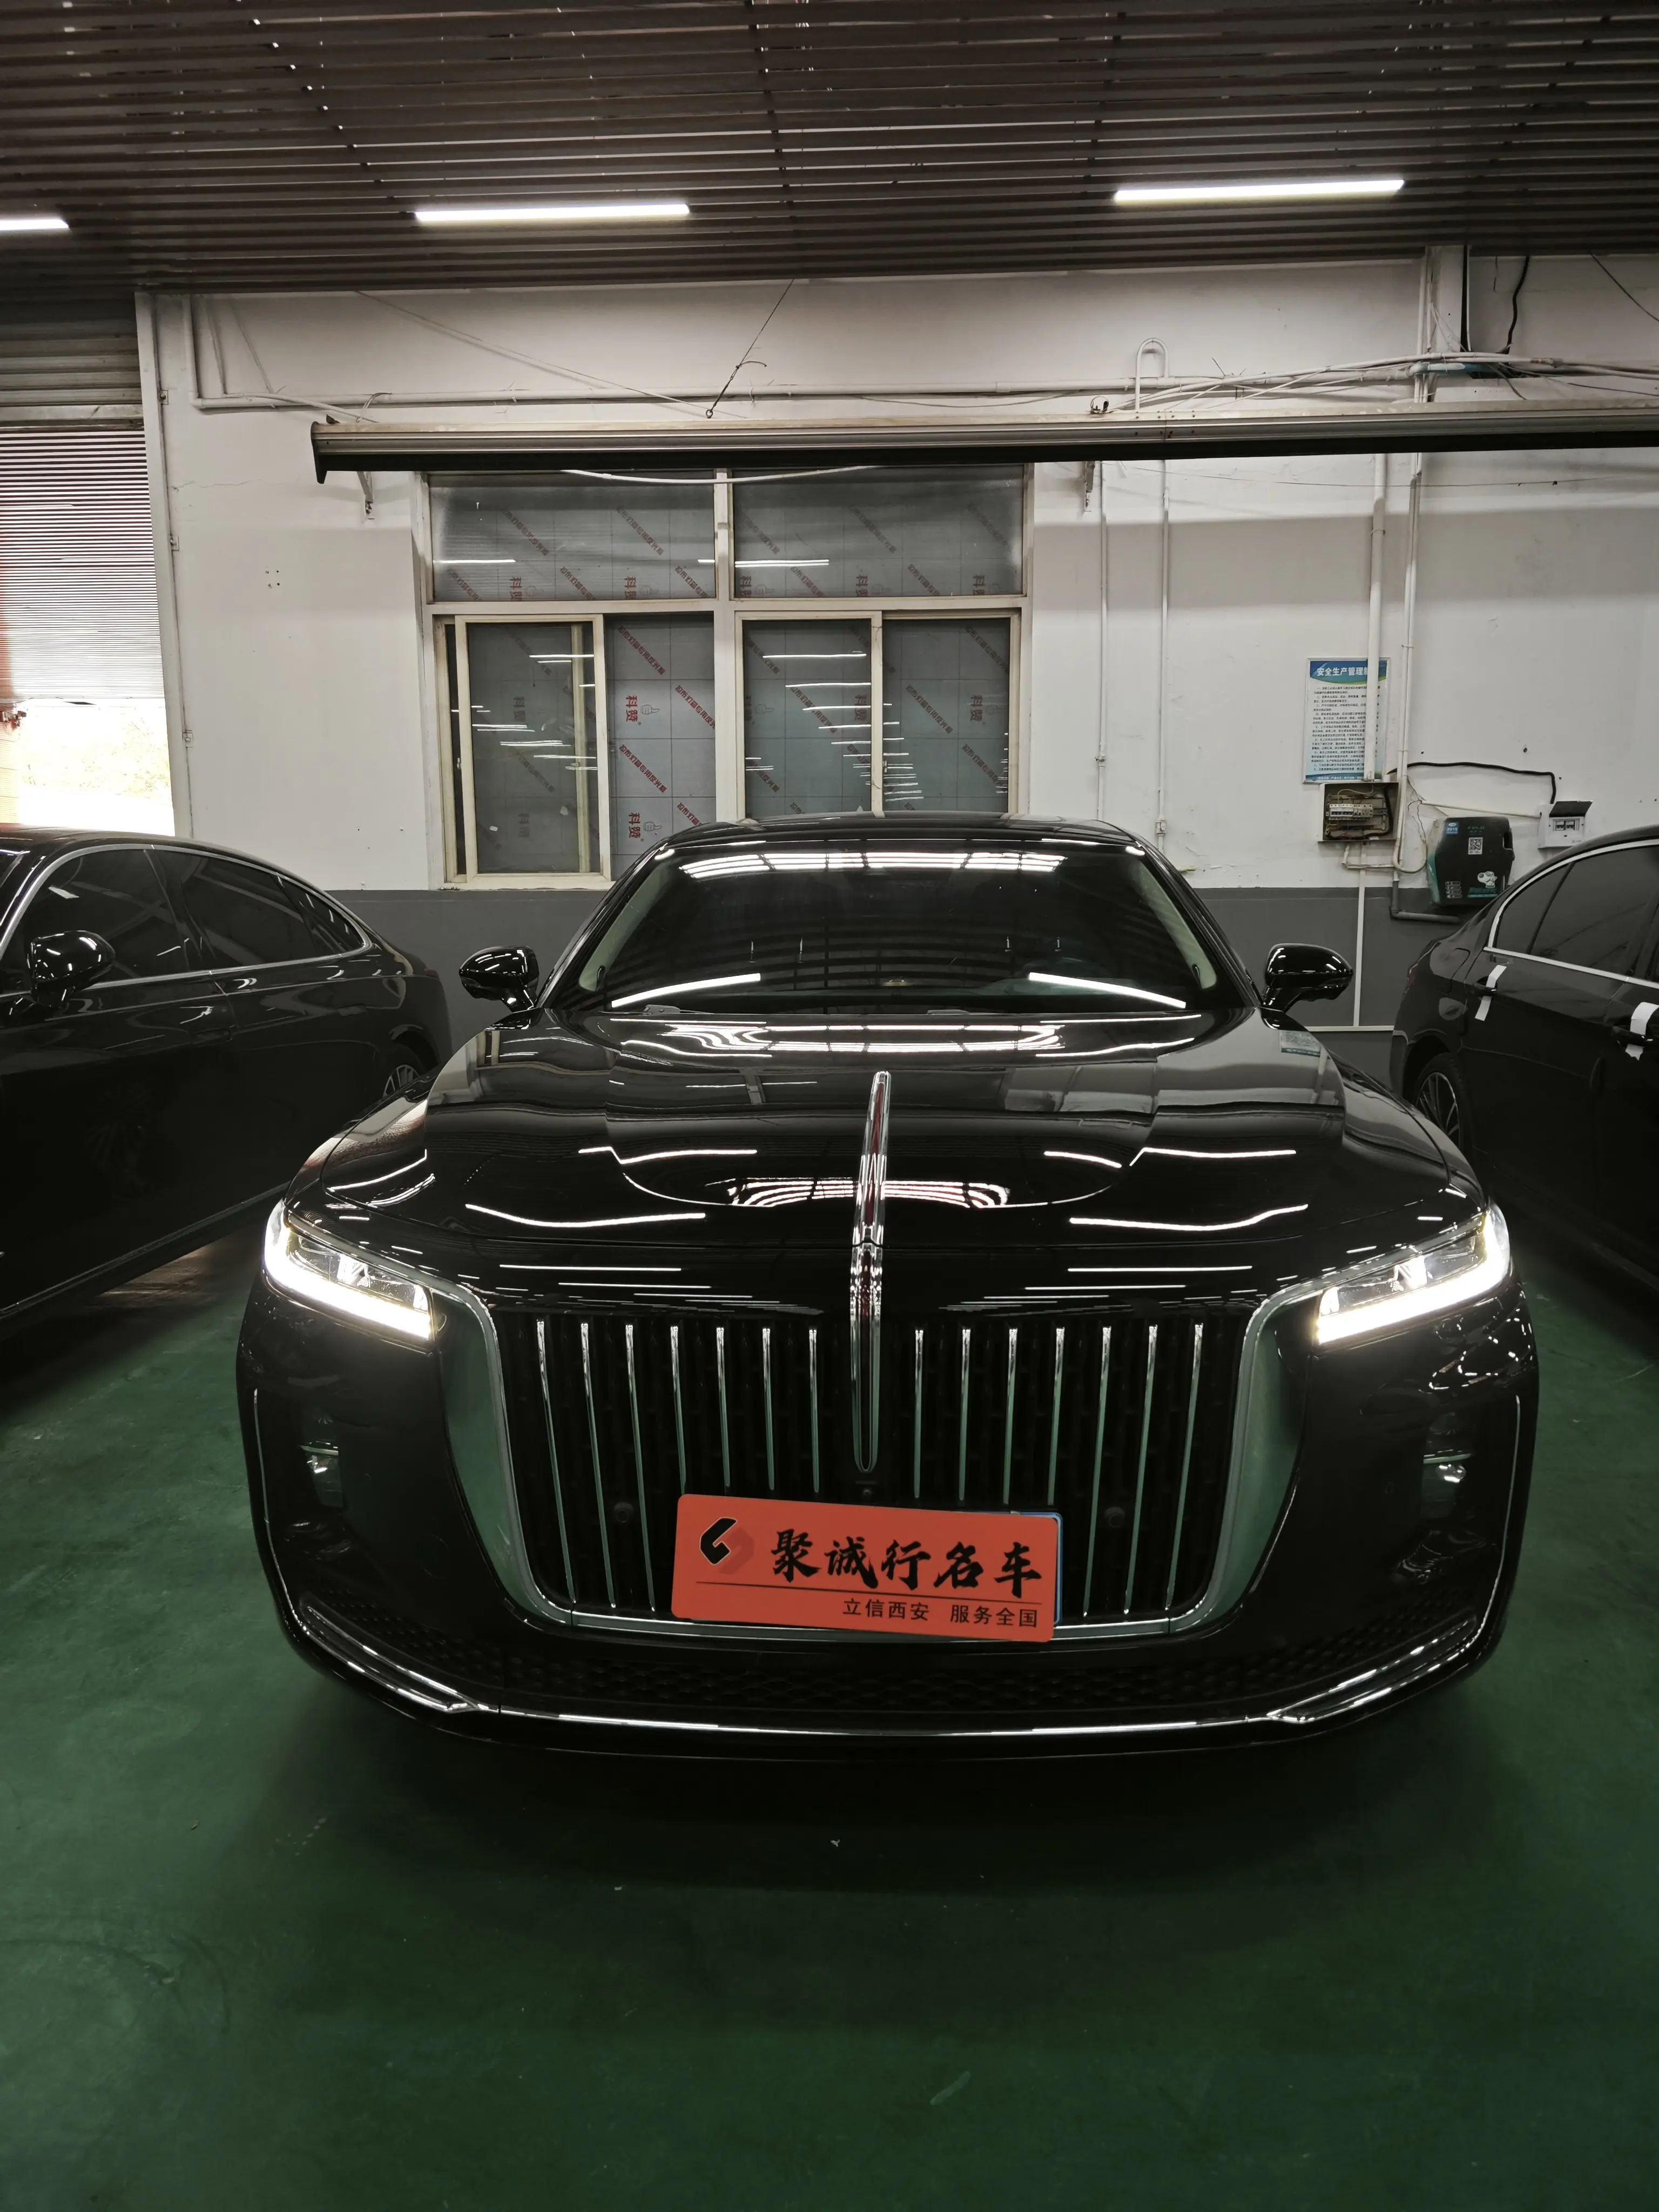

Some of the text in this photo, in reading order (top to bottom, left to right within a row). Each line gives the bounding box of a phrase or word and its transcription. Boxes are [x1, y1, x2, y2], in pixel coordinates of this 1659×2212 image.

[626, 695, 638, 721] 科赞
[970, 695, 983, 721] 科赞
[629, 813, 641, 838] 科赞
[677, 802, 703, 826] 拉布灯箱
[771, 1529, 1042, 1597] 聚诚行名车
[842, 1598, 1038, 1628] 立信西安 服务全国
